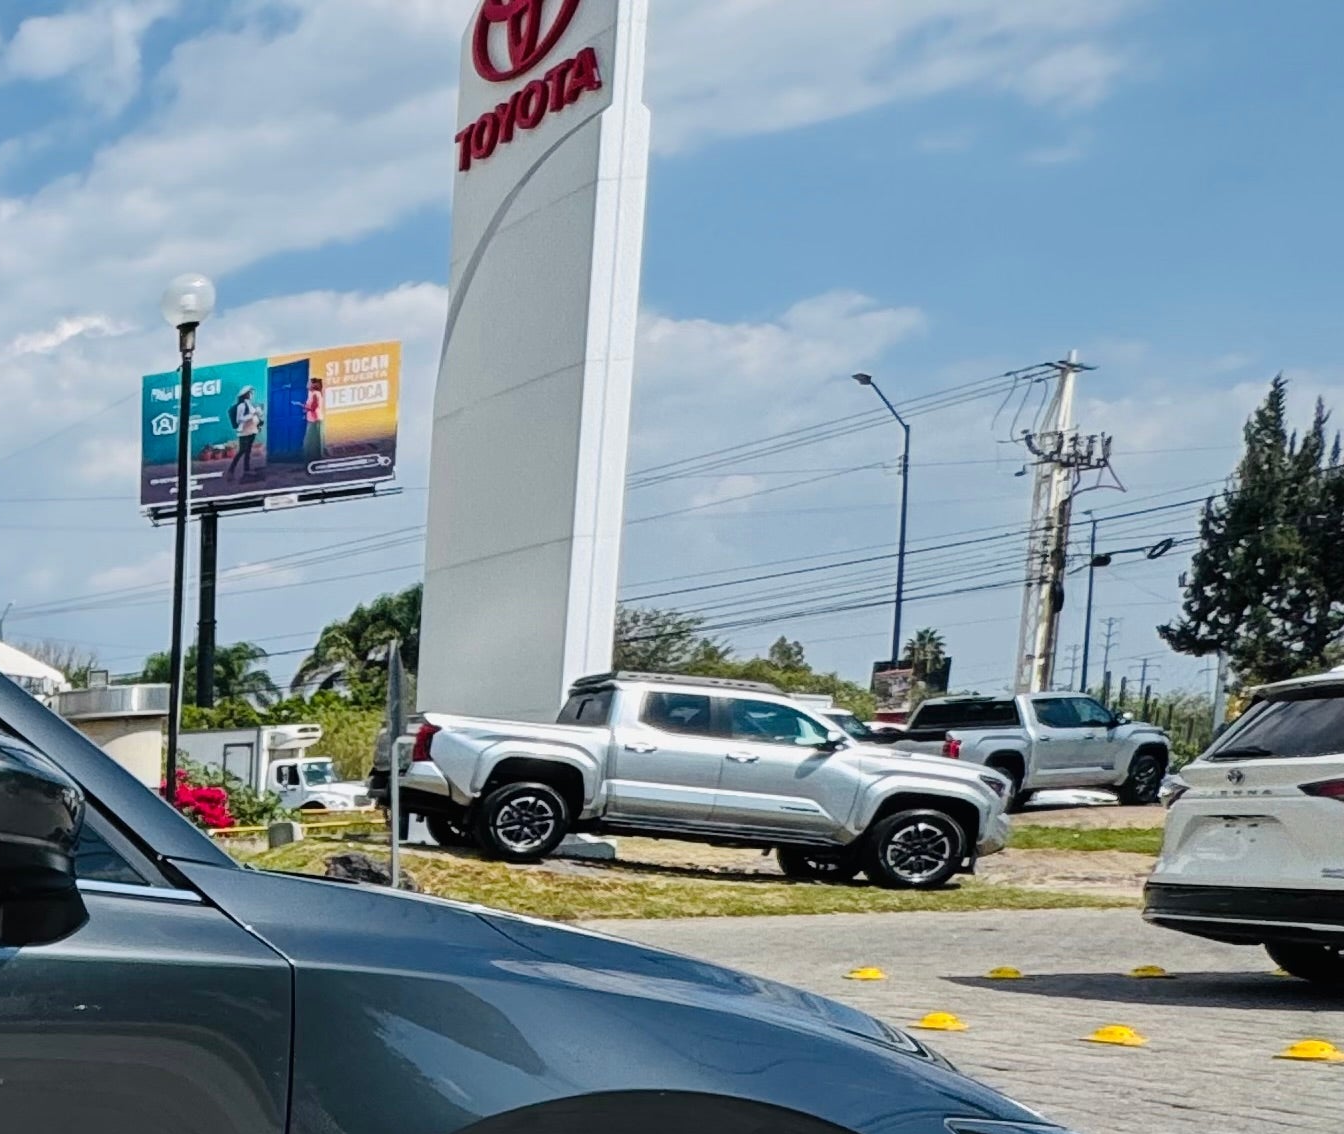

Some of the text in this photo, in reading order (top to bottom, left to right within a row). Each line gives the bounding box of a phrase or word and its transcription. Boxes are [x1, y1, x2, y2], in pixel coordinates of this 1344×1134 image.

[455, 47, 602, 172] TOYOTA
[326, 354, 389, 376] SI TOCAN
[332, 383, 383, 404] TE TOCA
